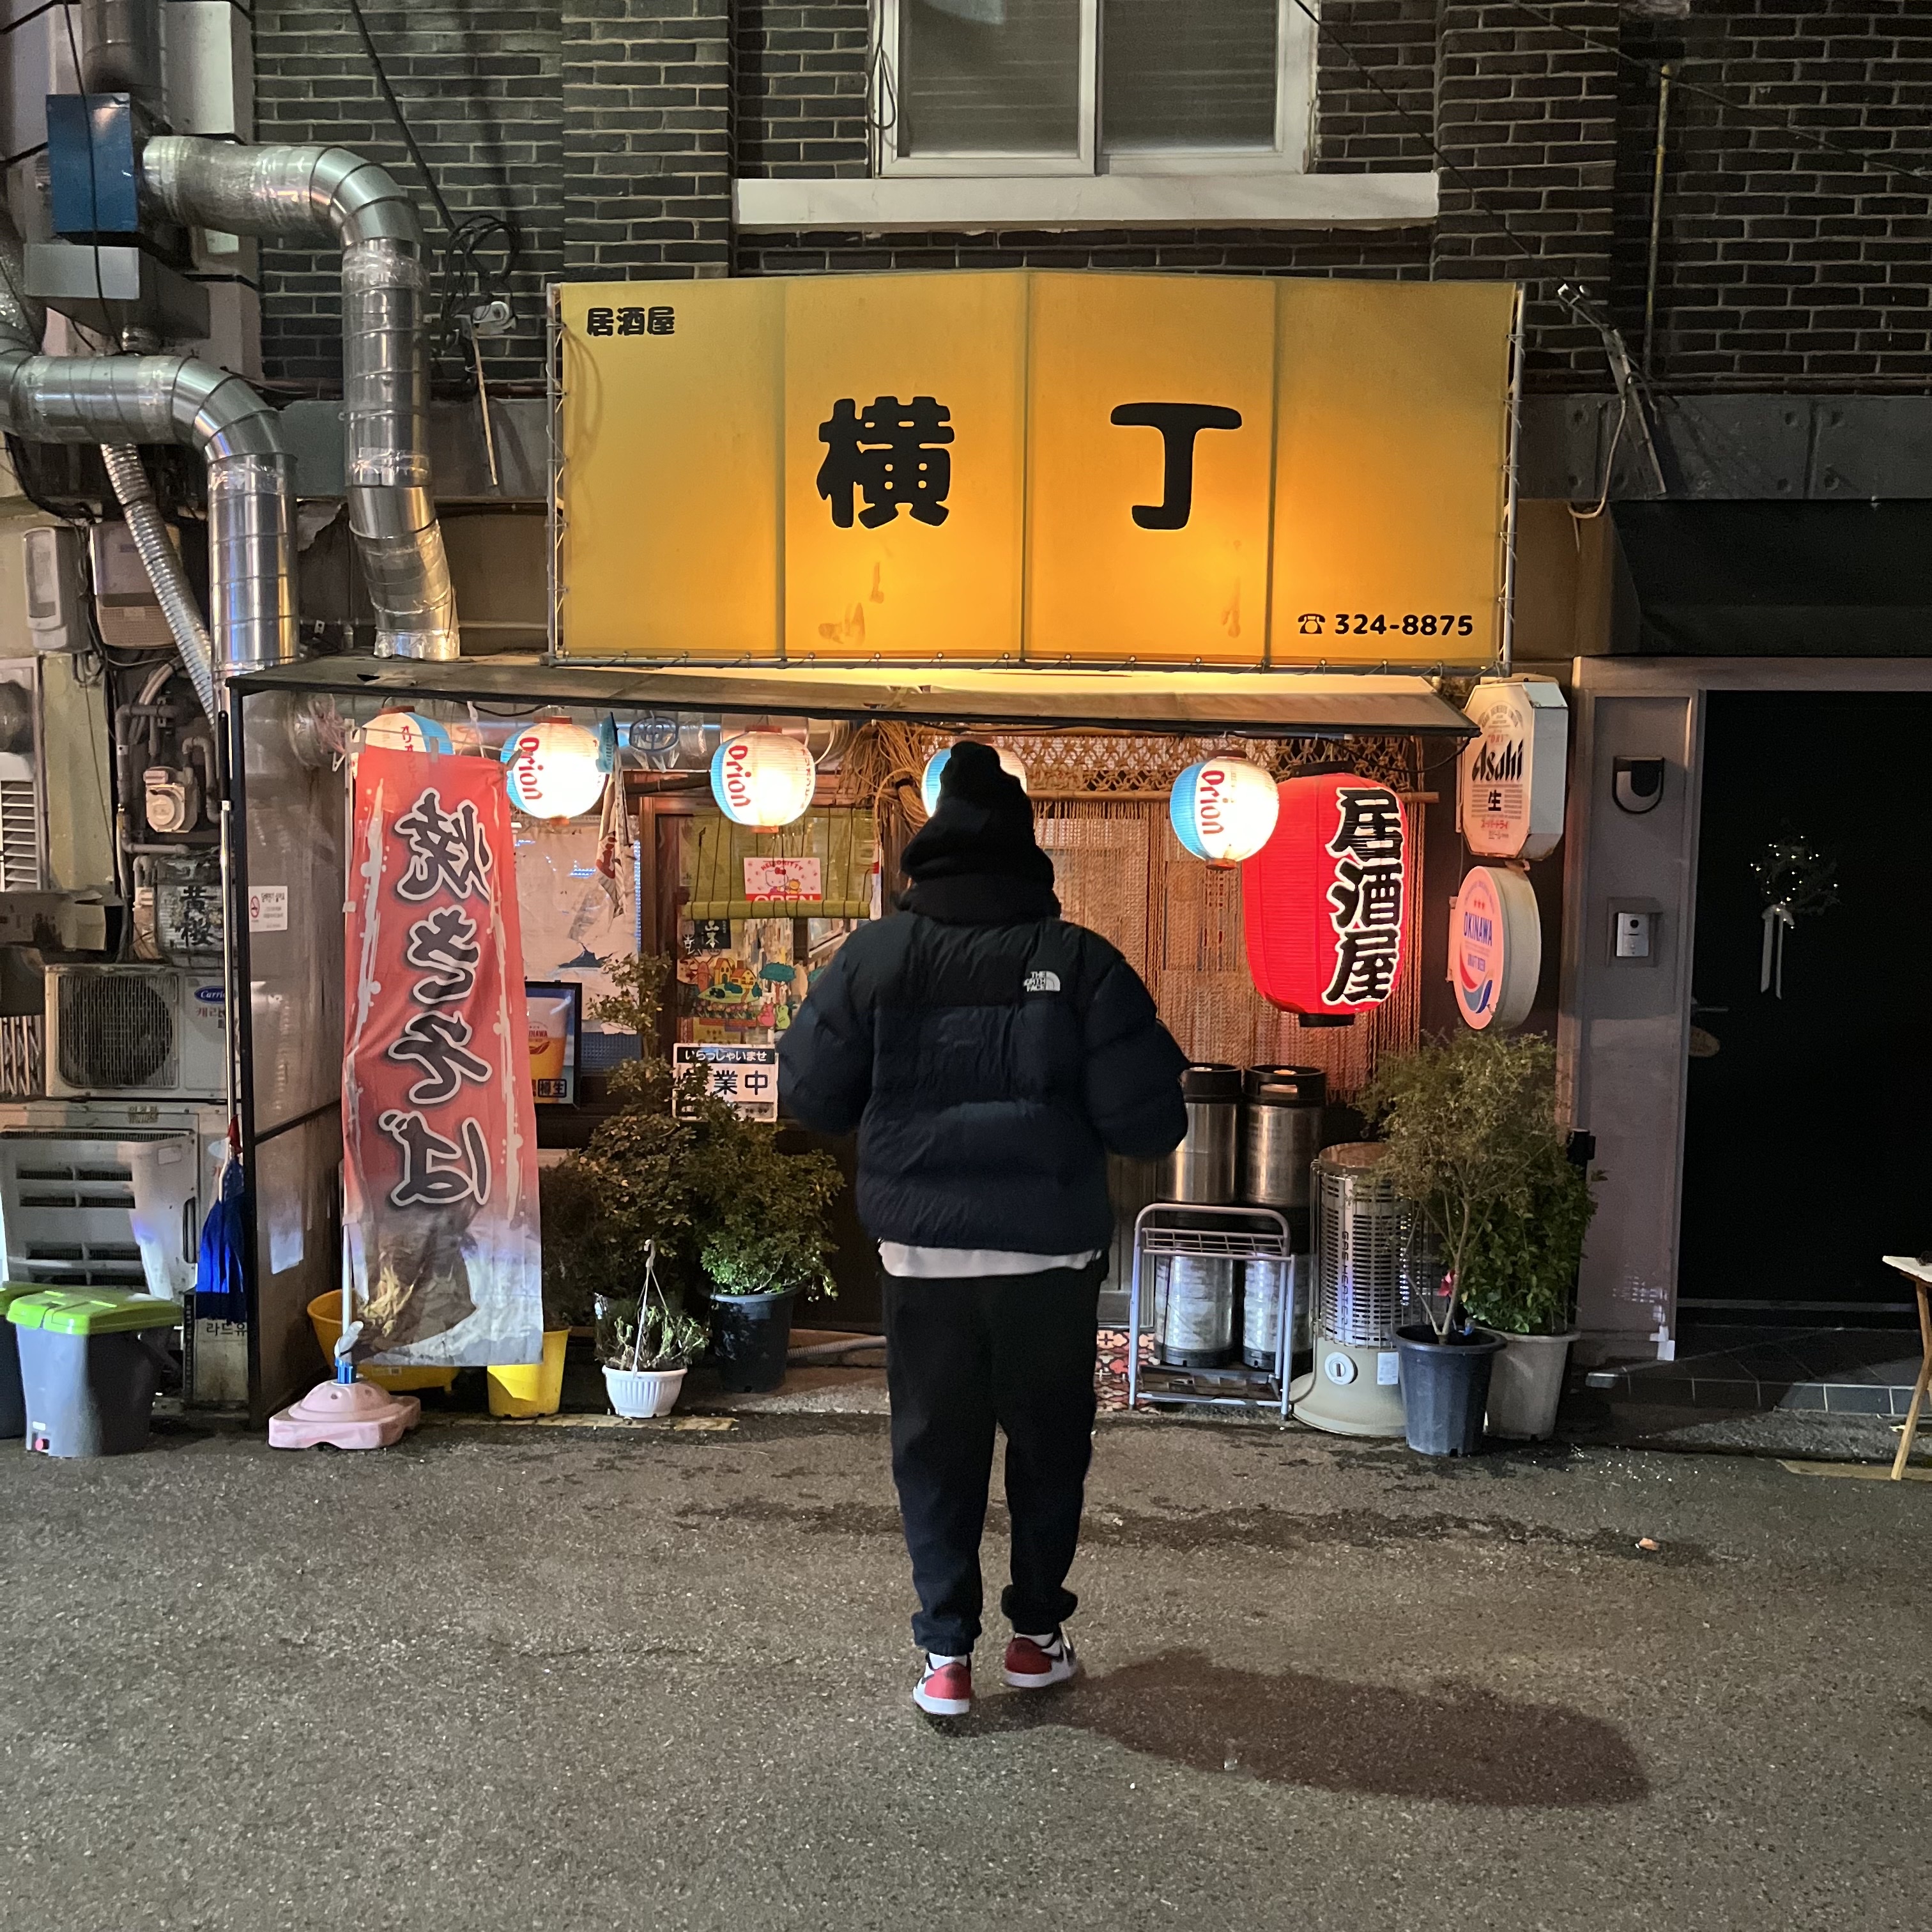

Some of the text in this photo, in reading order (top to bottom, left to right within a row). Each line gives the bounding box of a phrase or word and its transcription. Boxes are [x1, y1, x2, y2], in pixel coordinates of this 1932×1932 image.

[586, 305, 675, 337] 居酒屋
[1335, 613, 1473, 636] 324-8875
[1471, 739, 1524, 782] Asahi
[726, 744, 752, 807] Orion
[1199, 769, 1229, 834] Orion
[1487, 789, 1502, 811] 生
[761, 860, 782, 871] HELO
[1324, 787, 1404, 1004] 居酒屋
[1463, 911, 1492, 947] OKINAWA
[200, 990, 225, 999] Carri
[684, 1050, 767, 1062] いらっしゃいませ
[708, 1070, 769, 1096] 業中
